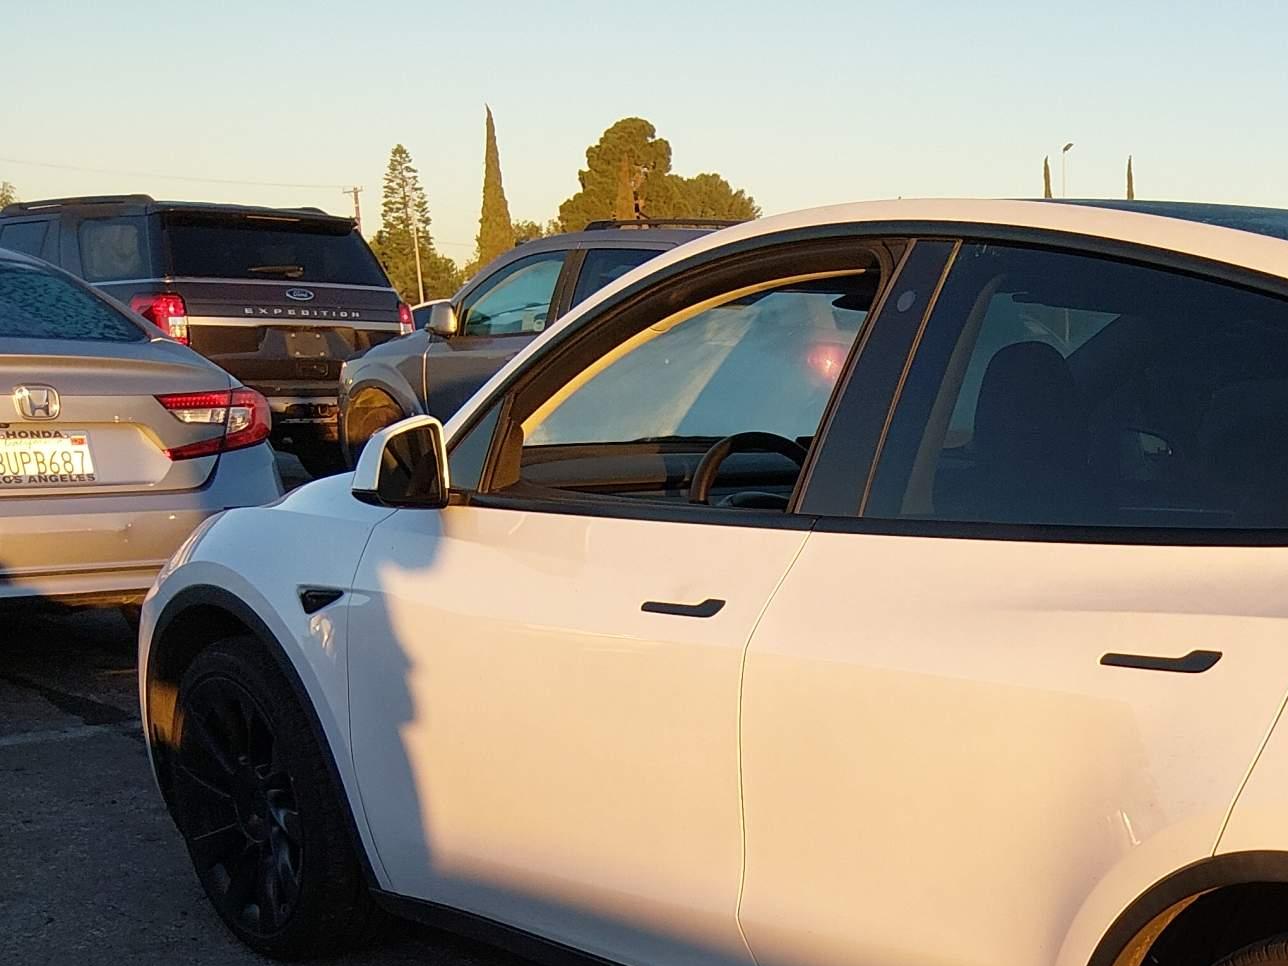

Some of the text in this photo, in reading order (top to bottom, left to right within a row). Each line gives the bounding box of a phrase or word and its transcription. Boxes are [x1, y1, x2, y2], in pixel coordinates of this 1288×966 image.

[244, 308, 360, 317] EXPEDITION
[6, 430, 63, 439] HONDA
[28, 473, 96, 483] ANGELES
